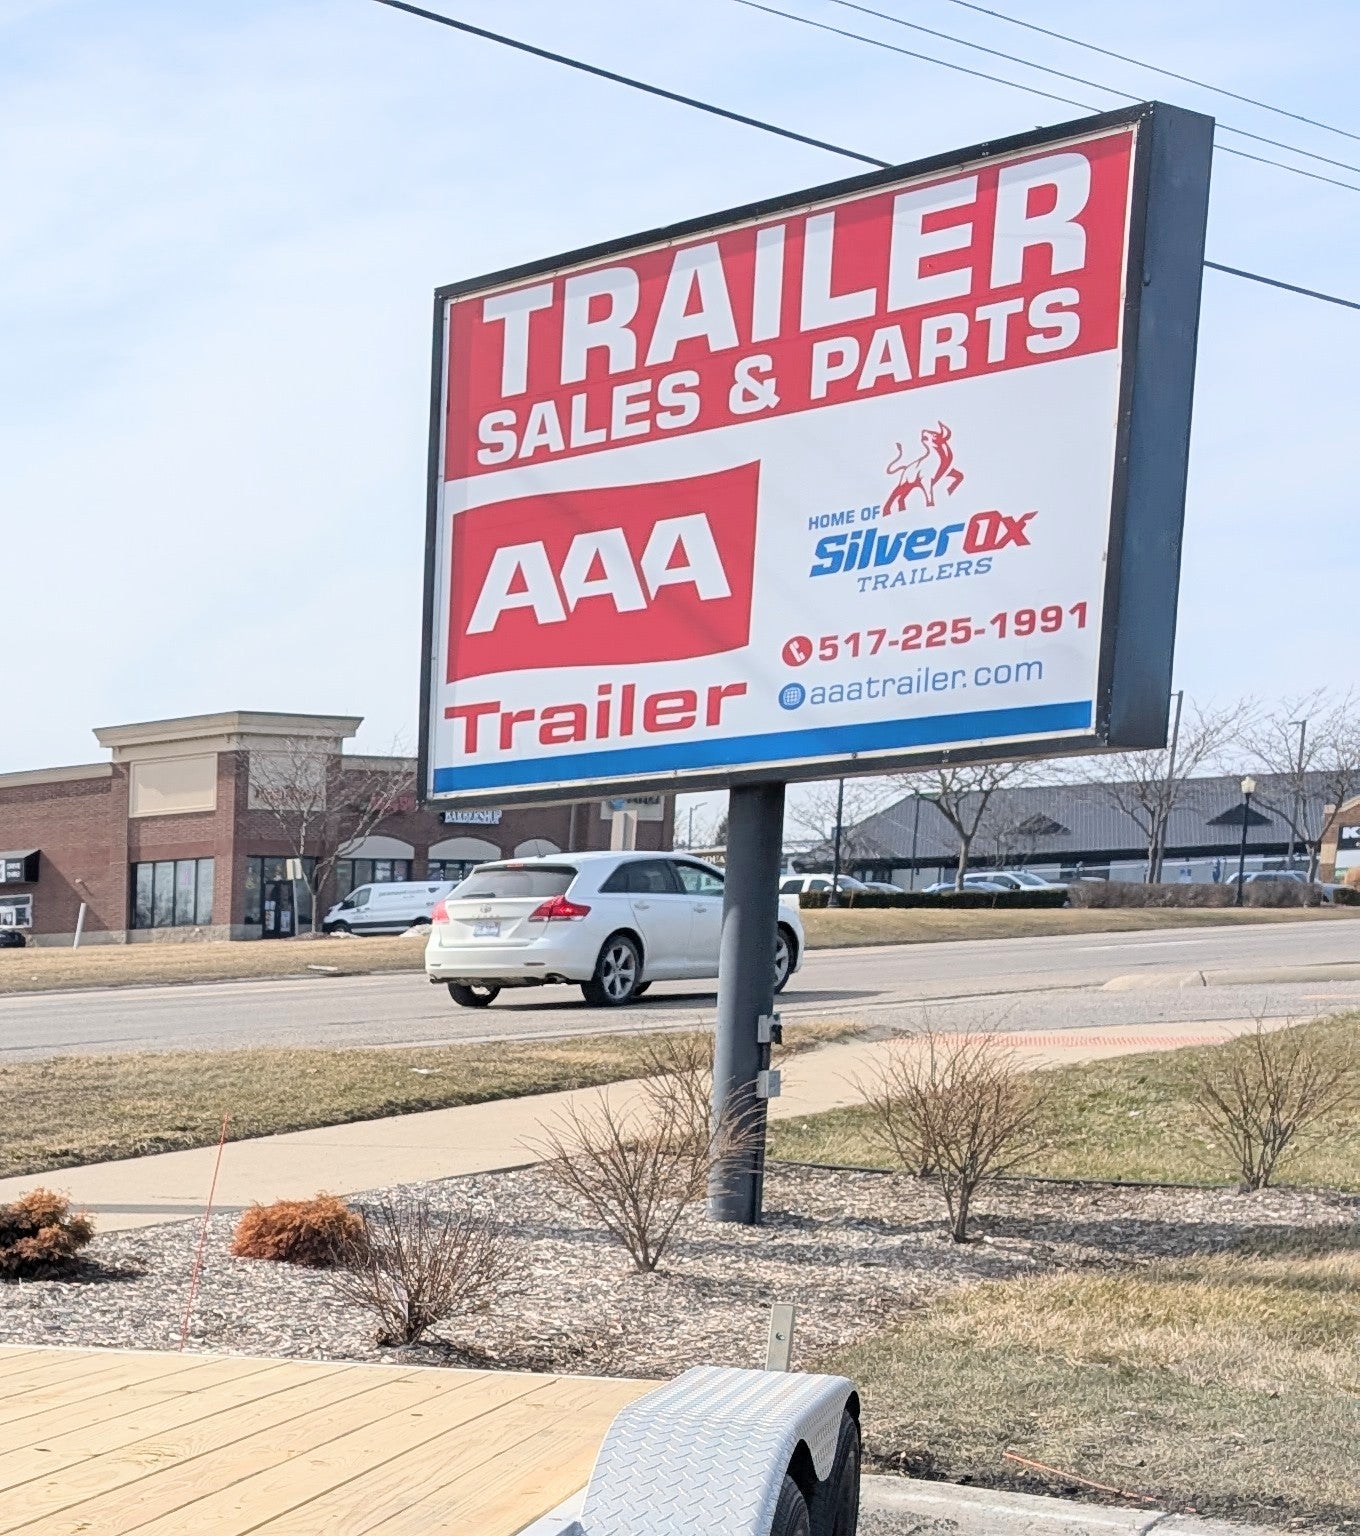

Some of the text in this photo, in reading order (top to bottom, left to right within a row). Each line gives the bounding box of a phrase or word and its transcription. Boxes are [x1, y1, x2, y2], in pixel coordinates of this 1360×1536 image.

[483, 151, 1093, 399] TRAILER
[476, 286, 1081, 467] SALES & PARTS
[808, 505, 881, 530] HOME OF
[465, 512, 732, 636] AAA
[857, 557, 993, 593] TRAILERS
[818, 601, 1088, 662] 517-225-1991
[810, 660, 1043, 705] aaatrailer.com
[445, 682, 747, 755] Trailer
